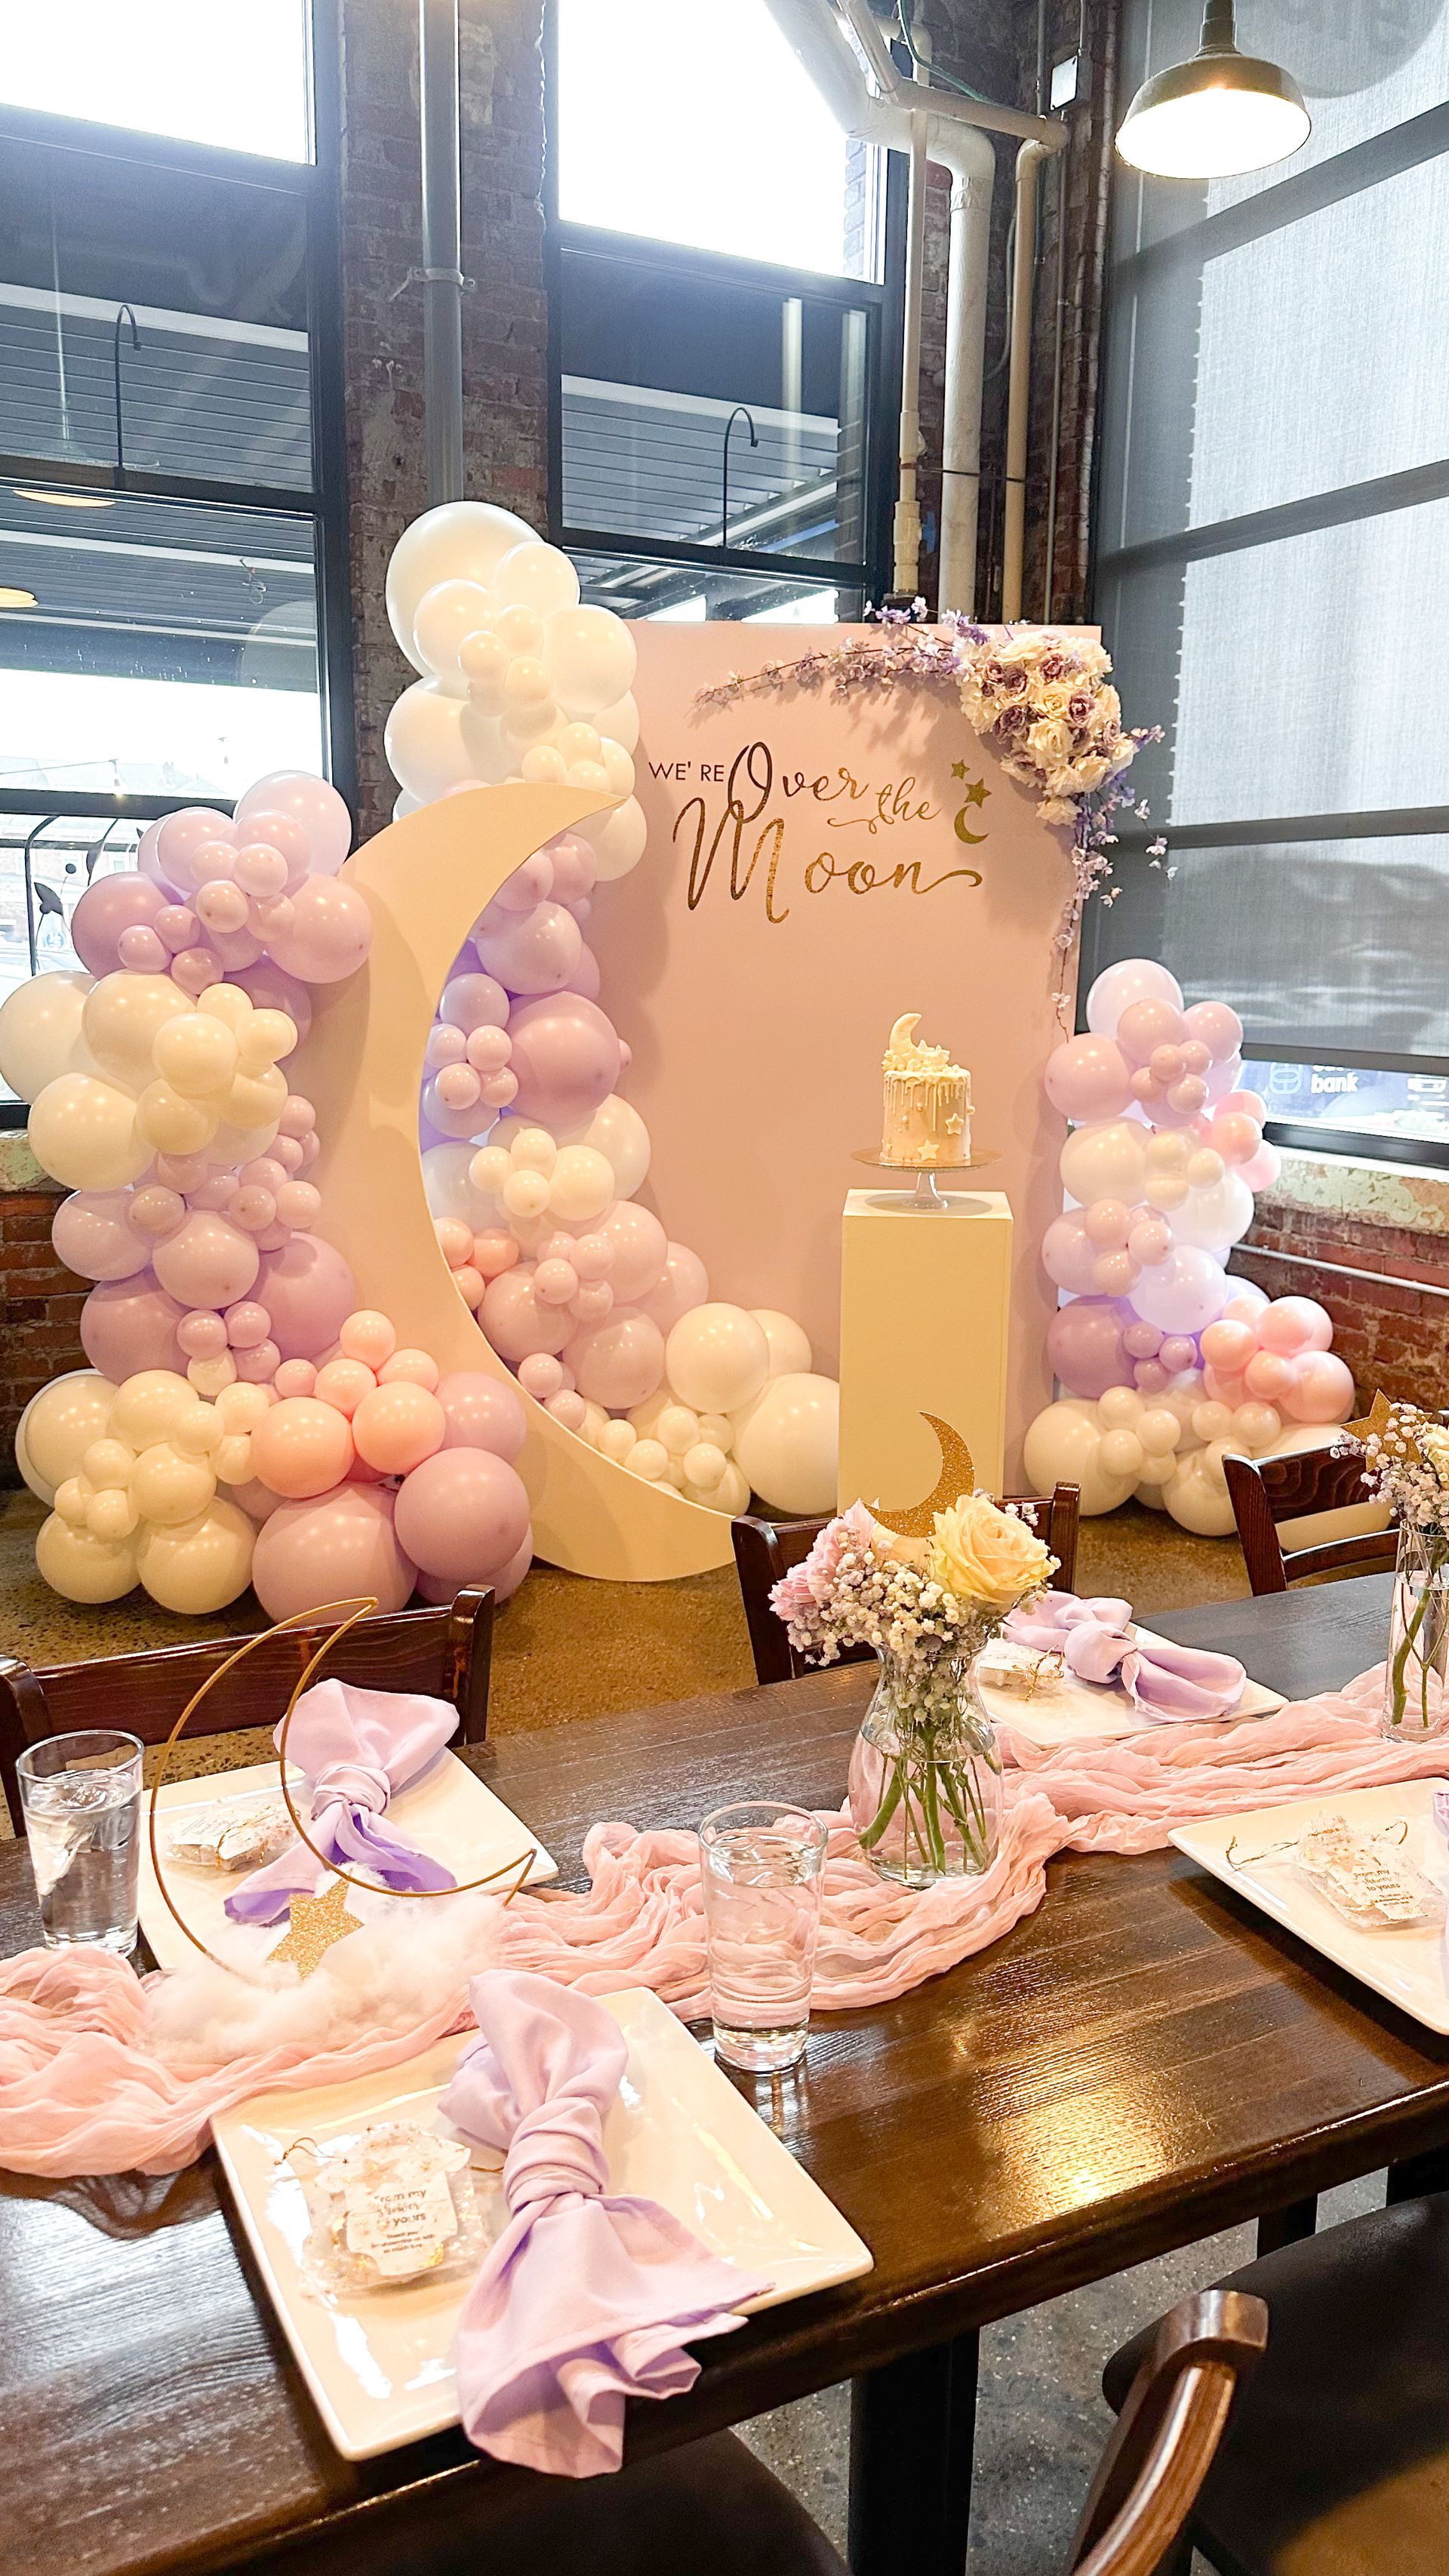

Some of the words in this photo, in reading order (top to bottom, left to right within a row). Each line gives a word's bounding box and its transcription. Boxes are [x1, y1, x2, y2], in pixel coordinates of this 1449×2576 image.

[727, 742, 869, 824] Over
[828, 776, 942, 835] the
[672, 797, 983, 925] Moon
[1311, 1072, 1359, 1094] bank
